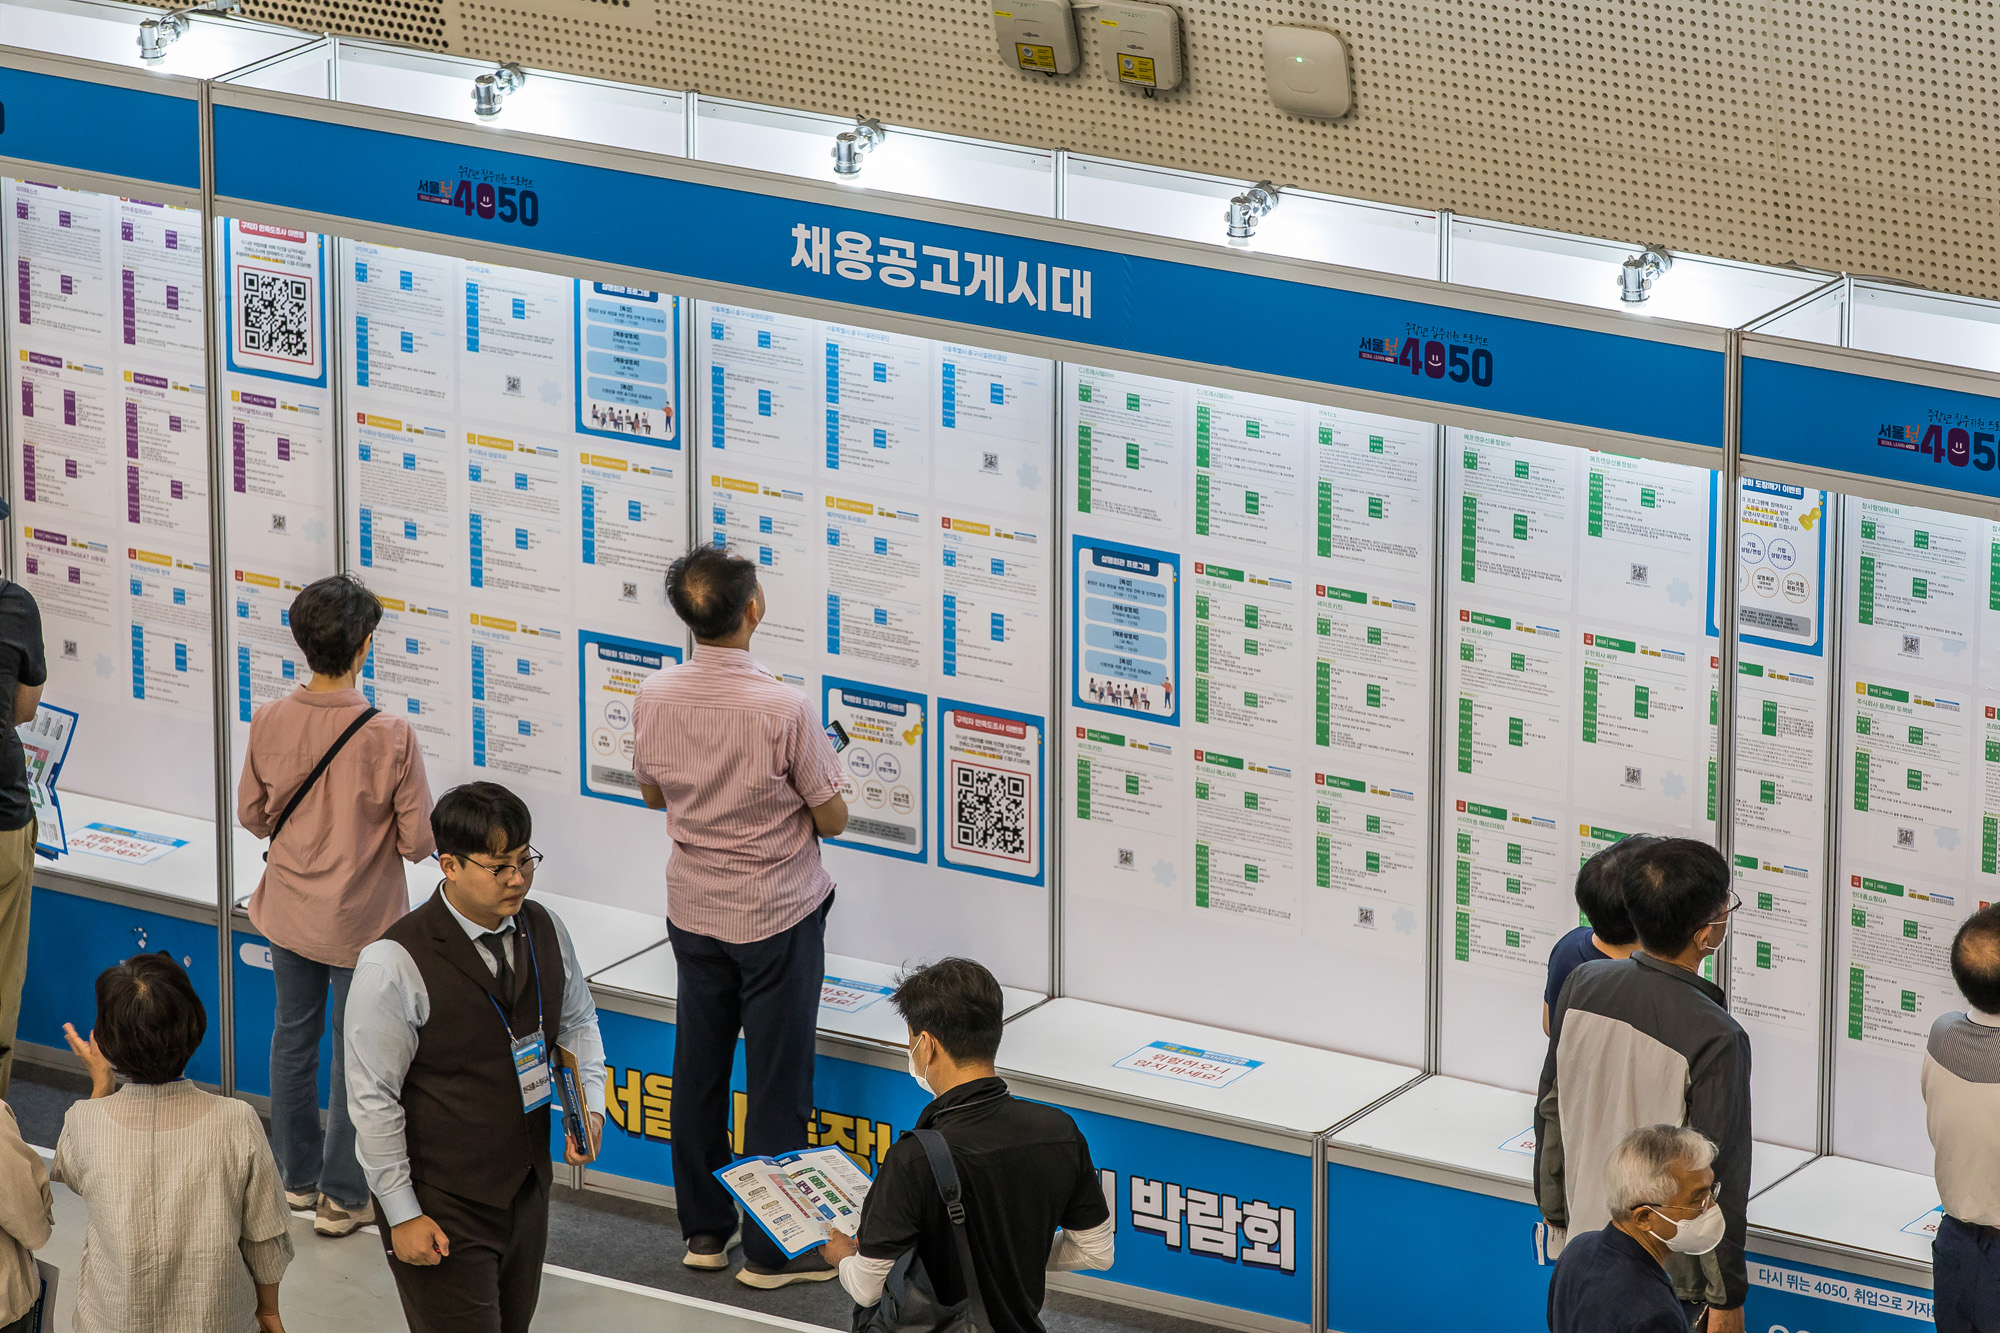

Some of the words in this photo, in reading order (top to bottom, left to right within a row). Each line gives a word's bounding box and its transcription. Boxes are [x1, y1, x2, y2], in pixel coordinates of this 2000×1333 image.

[418, 180, 453, 198] 서울런
[454, 180, 539, 227] 4050
[792, 223, 1092, 319] 채용공고게시대
[1463, 334, 1489, 347] 프로젝트
[1360, 337, 1398, 356] 서울런
[1399, 337, 1493, 387] 4050
[1879, 424, 1920, 443] 서울런
[1921, 424, 2000, 472] 405
[1783, 485, 1802, 495] 이벤트
[1771, 501, 1793, 511] 참여하시고
[1743, 510, 1774, 520] 운영사무국으로
[1741, 547, 1761, 556] 상담/면접
[1771, 552, 1791, 561] 상담/면접
[1857, 698, 1879, 708] 주식회사
[1152, 1054, 1232, 1074] 위험하오니
[1170, 1067, 1223, 1081] 마세요!
[1131, 1175, 1296, 1272] 박람회
[1759, 1268, 1782, 1287] 다시
[1787, 1274, 1811, 1292] 뛰는
[1814, 1282, 1850, 1301] 4050,
[1854, 1289, 1902, 1311] 취업으로
